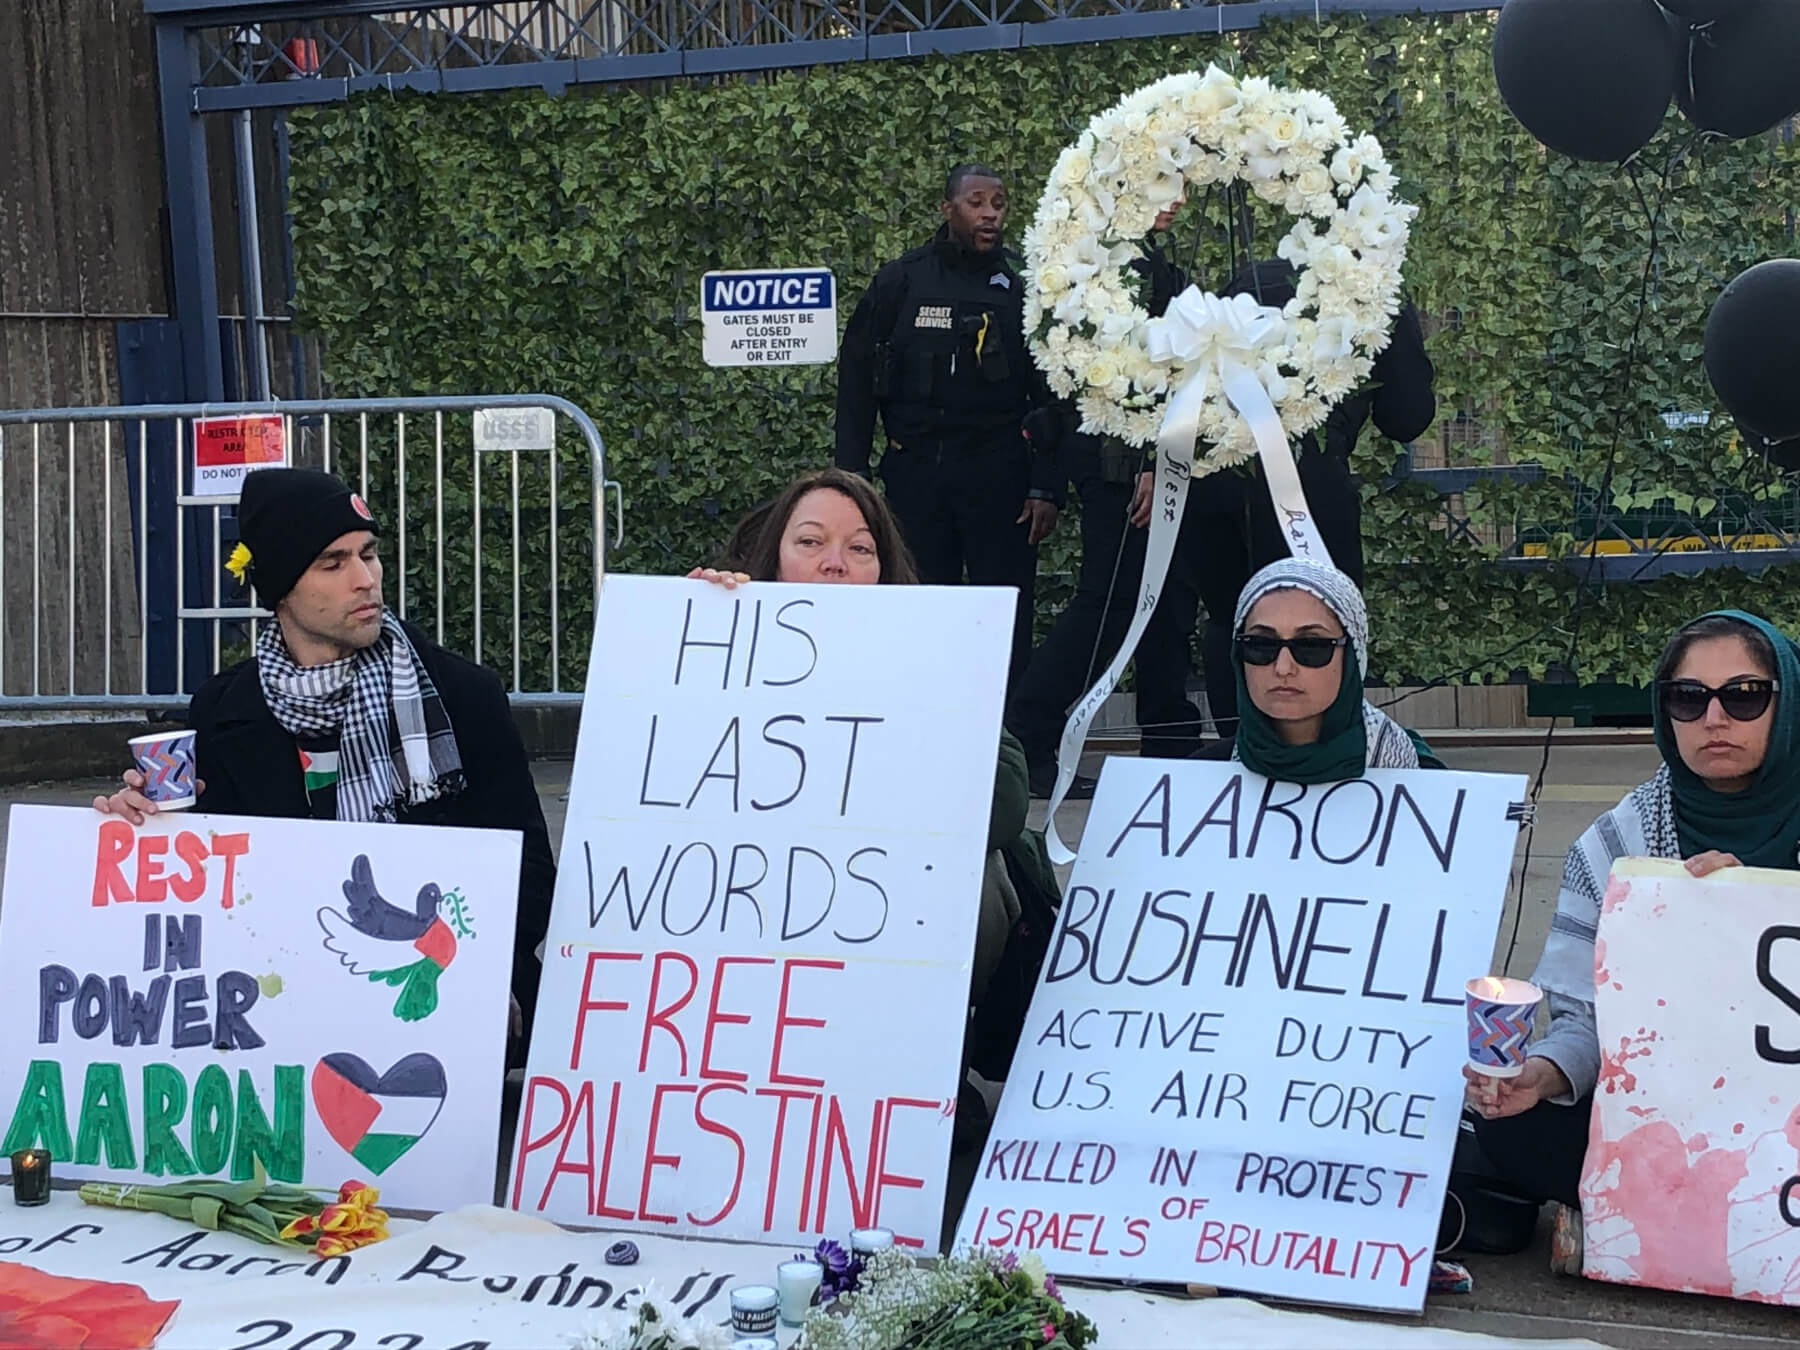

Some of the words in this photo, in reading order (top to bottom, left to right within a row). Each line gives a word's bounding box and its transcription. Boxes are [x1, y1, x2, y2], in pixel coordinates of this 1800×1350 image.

[713, 278, 822, 306] NOTICE
[722, 314, 759, 326] GATES
[762, 313, 796, 325] MUST
[798, 312, 815, 324] BE
[914, 316, 953, 329] SERVICE
[919, 305, 953, 317] SECRET
[730, 339, 767, 350] AFTER
[771, 337, 808, 349] ENTRY
[746, 326, 791, 337] CLOSED
[746, 350, 763, 361] OR
[767, 350, 792, 361] EXIT
[202, 469, 218, 480] DO
[221, 467, 242, 478] NOT
[674, 598, 817, 690] HIS
[639, 714, 886, 816] LAST
[1106, 773, 1467, 874] AARON
[91, 820, 250, 910] REST
[143, 913, 202, 973] IN
[1044, 885, 1465, 1006] BUSHNELL
[37, 964, 266, 1050] POWER
[1037, 1008, 1225, 1053] ACTIVE
[1275, 1016, 1433, 1070] DUTY
[1, 1060, 304, 1183] AARON
[1032, 1070, 1114, 1111] U.S.
[1150, 1069, 1248, 1122] AIR
[1279, 1079, 1437, 1141] FORCE
[984, 1139, 1117, 1186] KILLED
[1149, 1146, 1198, 1188] IN
[1235, 1151, 1429, 1209] PROTEST
[0, 1224, 104, 1253] of
[1160, 1196, 1210, 1221] OF
[972, 1206, 1151, 1258] ISRAEL'S
[1194, 1220, 1429, 1288] BRUTALITY
